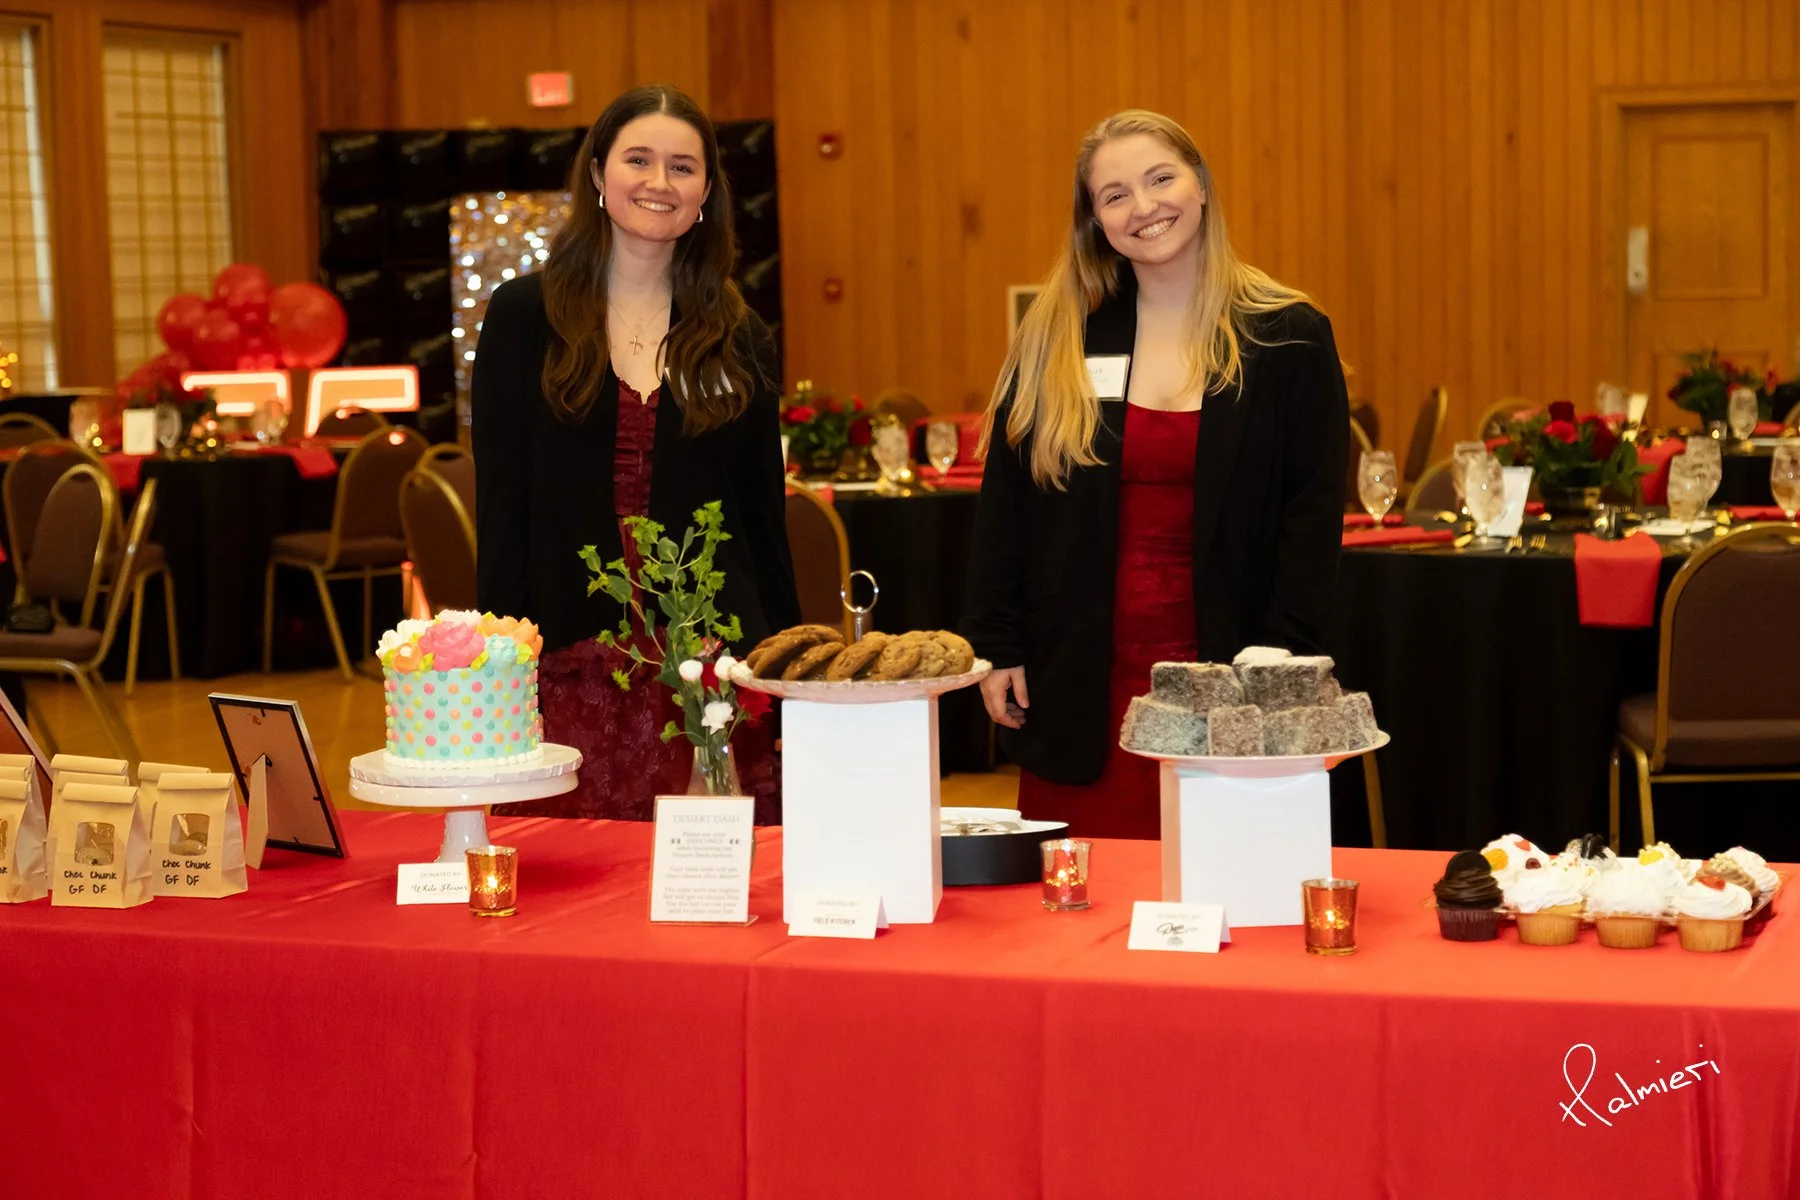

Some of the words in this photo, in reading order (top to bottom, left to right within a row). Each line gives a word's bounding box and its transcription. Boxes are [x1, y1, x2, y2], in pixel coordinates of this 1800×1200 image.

[673, 815, 711, 823] DESSERT
[714, 815, 740, 823] DASH
[185, 860, 212, 870] Chunk
[89, 870, 117, 880] Chunk
[165, 874, 180, 885] GF
[186, 874, 200, 886] DF
[69, 884, 85, 895] GF
[92, 884, 107, 894] DF
[813, 916, 829, 925] FIELD
[830, 917, 856, 925] KITCHEN
